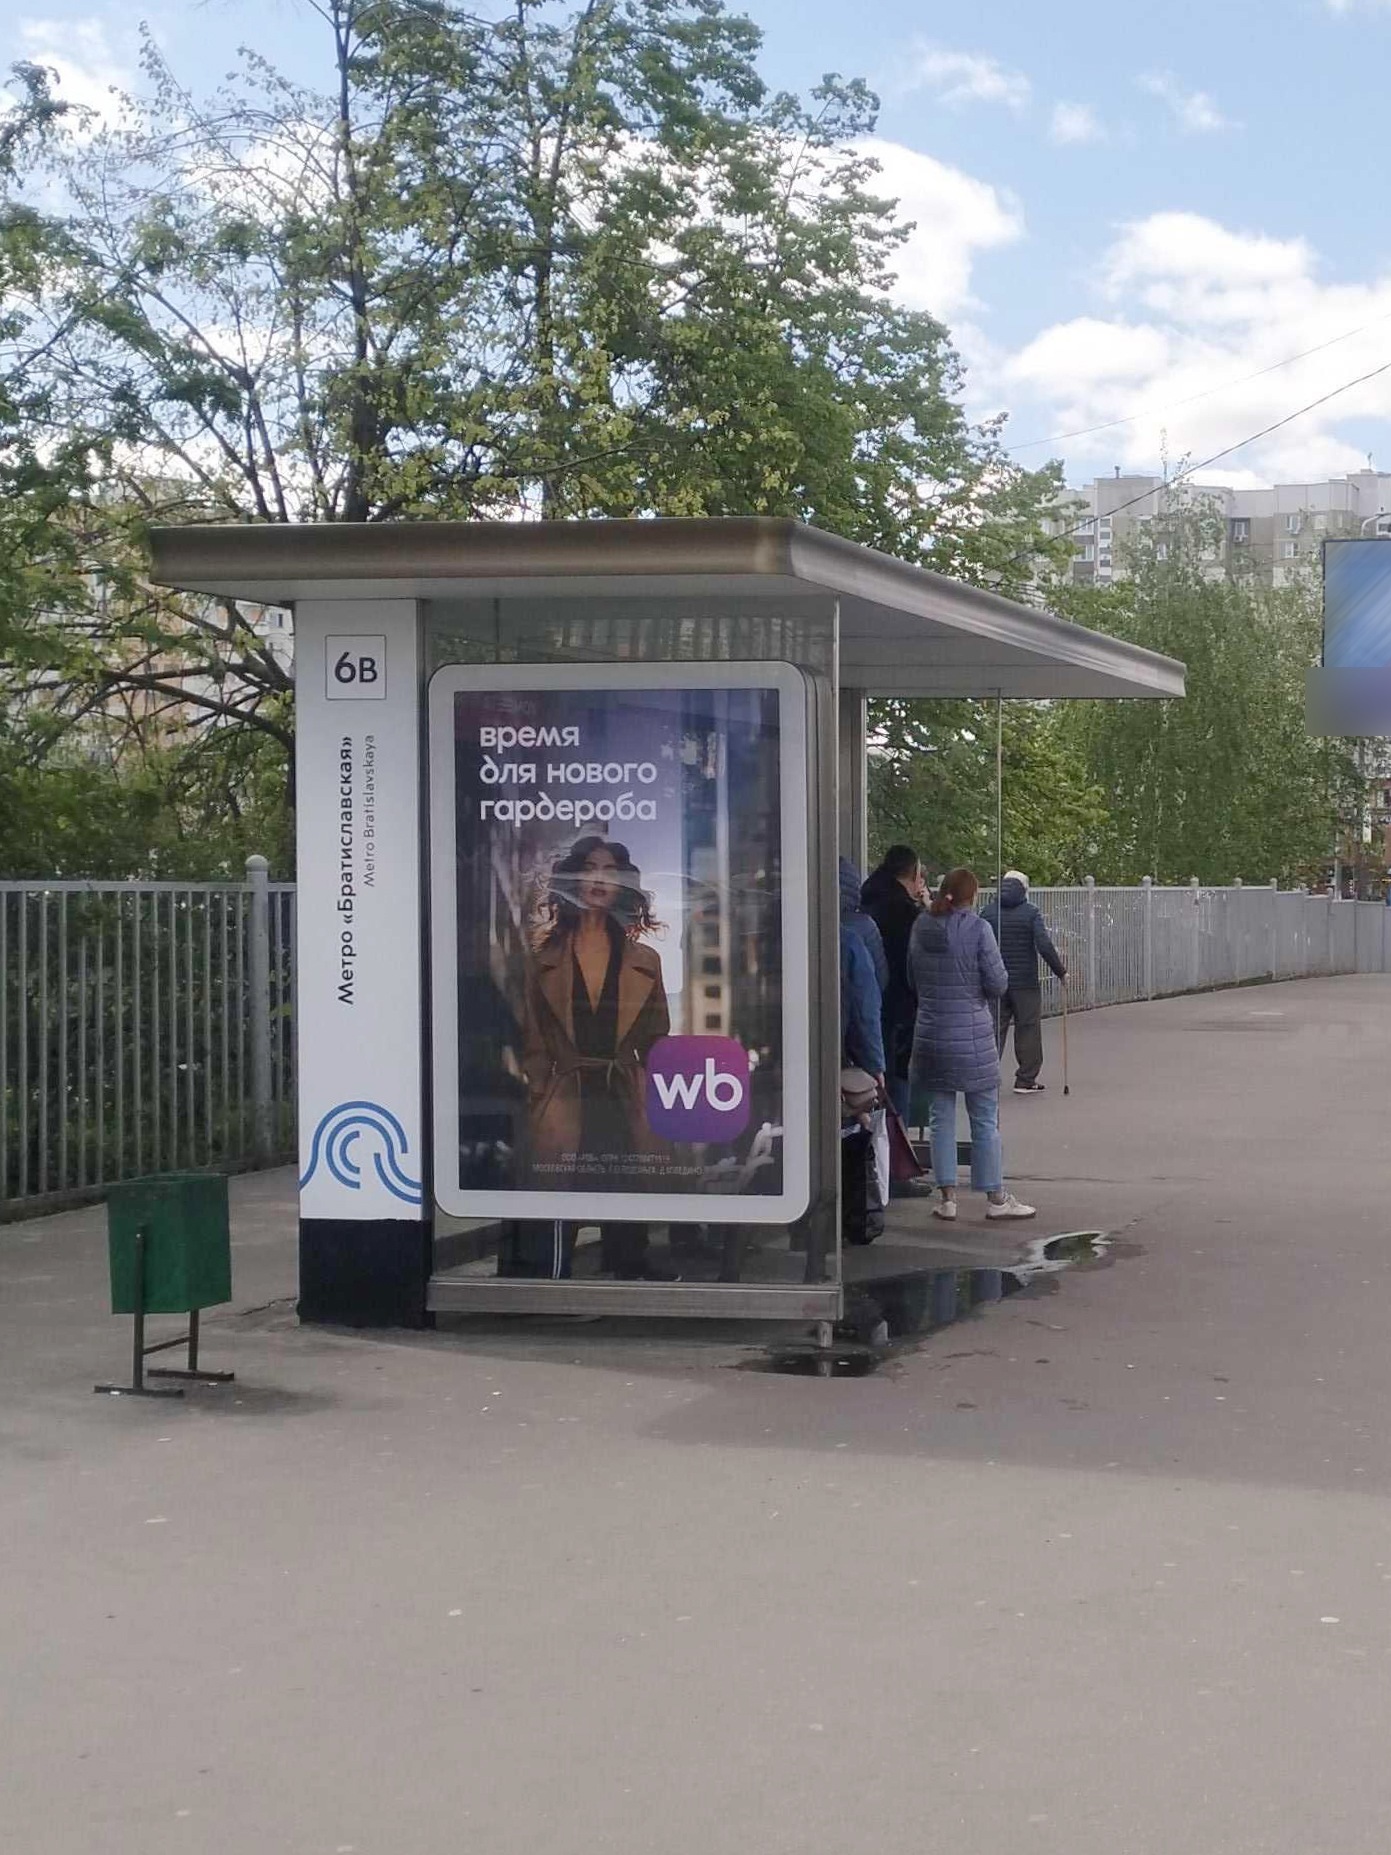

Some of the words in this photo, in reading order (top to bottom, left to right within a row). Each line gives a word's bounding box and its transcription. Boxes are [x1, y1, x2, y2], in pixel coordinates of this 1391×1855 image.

[479, 726, 580, 754] время
[362, 734, 377, 838] Bratislavskaya
[479, 754, 537, 784] для
[547, 762, 658, 784] нового
[337, 736, 357, 925] «Братиславская»
[480, 791, 657, 828] гардероба
[363, 842, 375, 887] Metro
[337, 930, 357, 1005] Метро
[652, 1057, 743, 1111] wb
